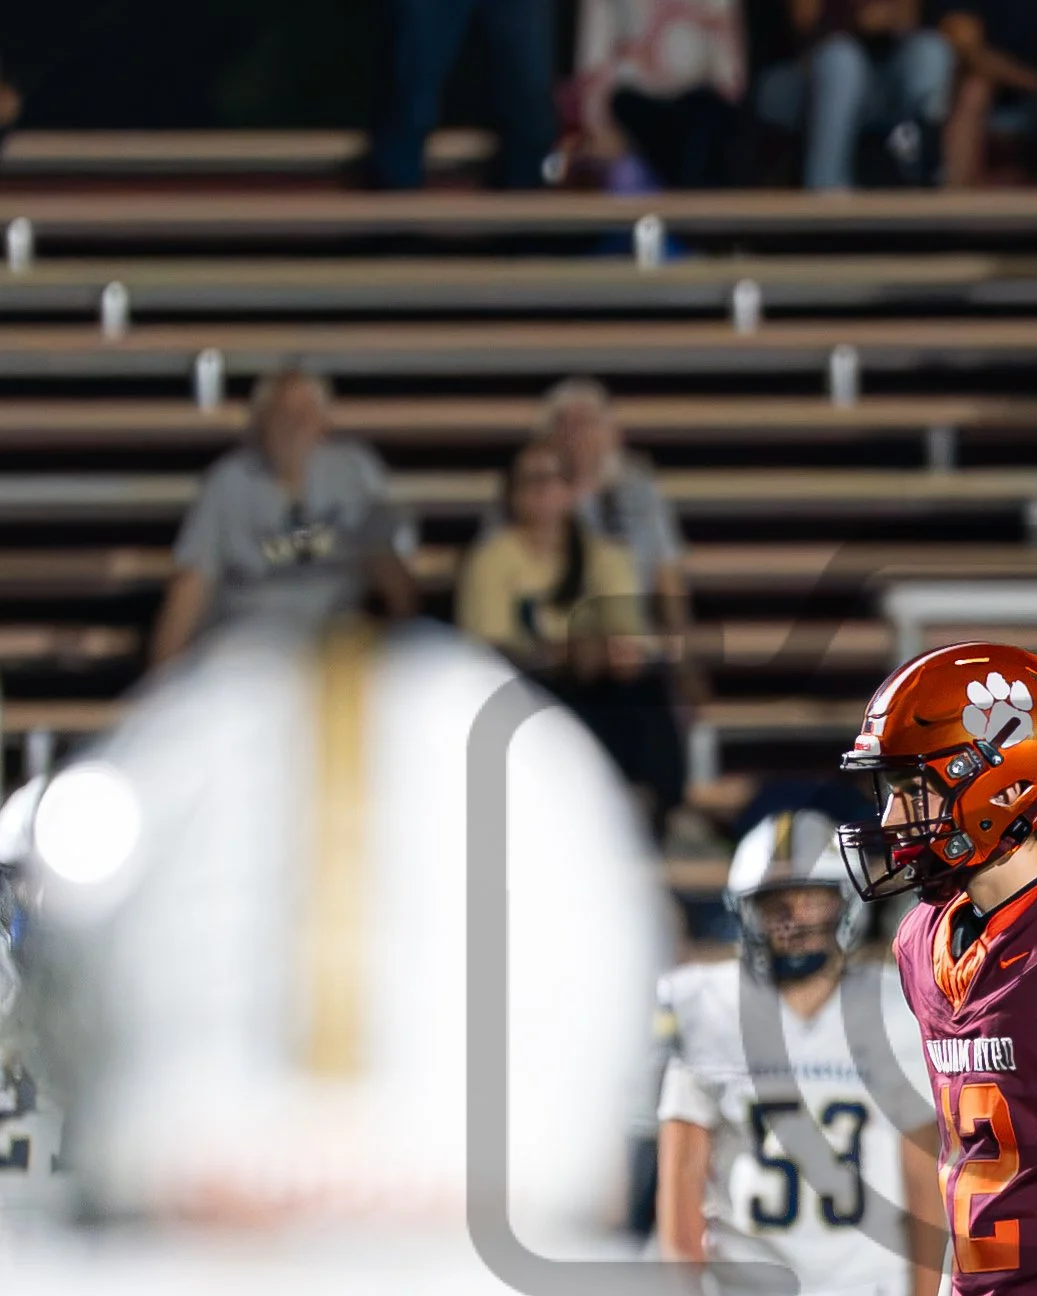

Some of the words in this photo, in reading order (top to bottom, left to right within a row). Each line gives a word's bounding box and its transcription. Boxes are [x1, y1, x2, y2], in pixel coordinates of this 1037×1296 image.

[973, 1037, 1017, 1072] BYRD
[751, 1101, 870, 1227] 53
[939, 1083, 1020, 1274] 12
